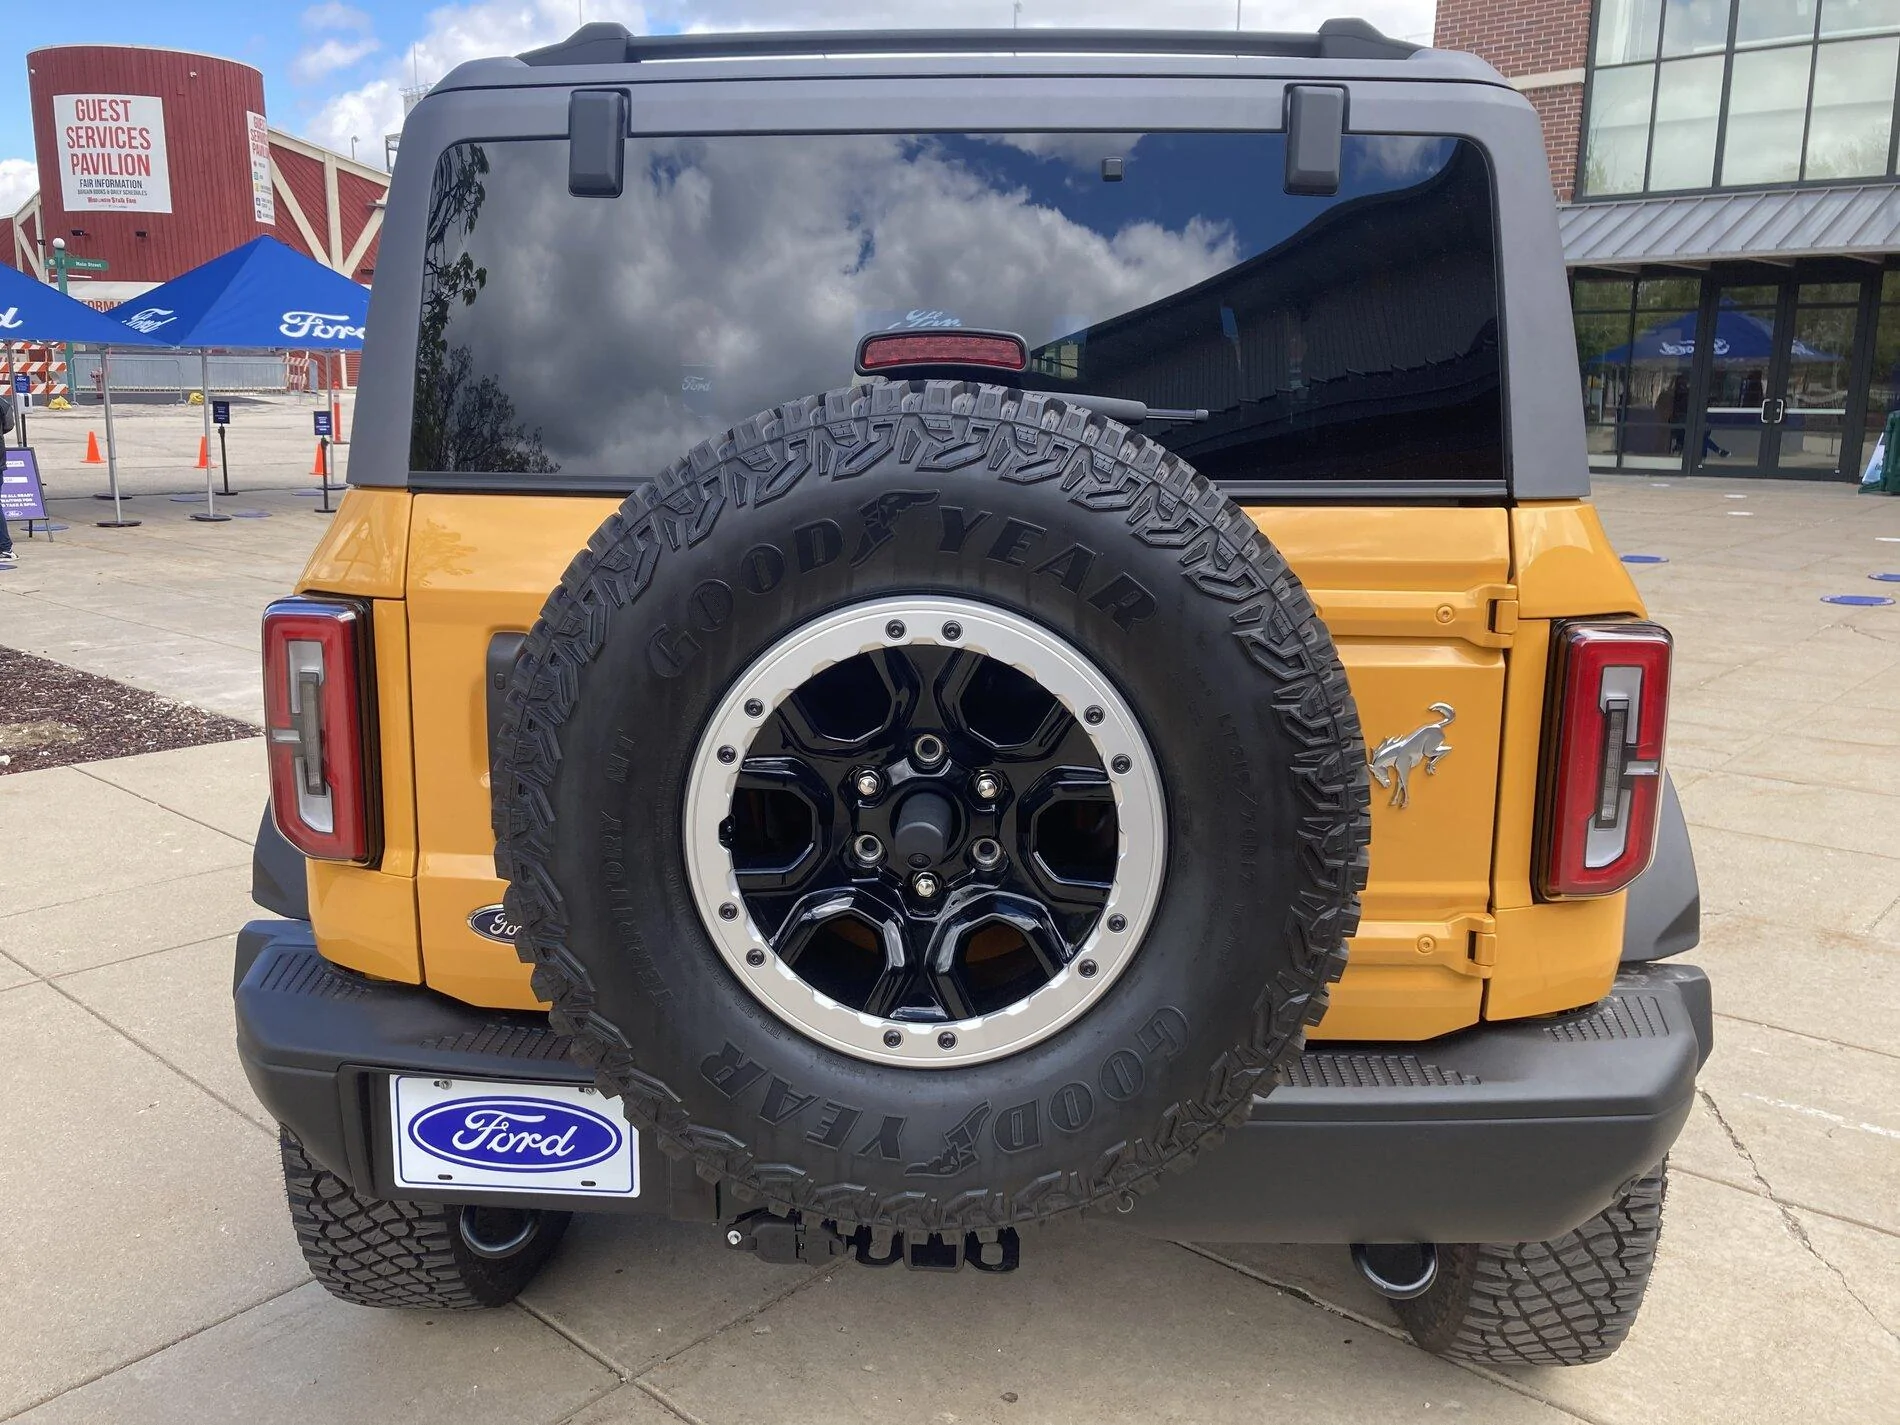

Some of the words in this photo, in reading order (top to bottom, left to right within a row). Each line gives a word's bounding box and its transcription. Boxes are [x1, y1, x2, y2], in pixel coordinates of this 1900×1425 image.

[75, 99, 131, 122] GUEST
[66, 126, 151, 150] SERVICES
[70, 153, 151, 176] PAVILION
[79, 179, 93, 188] FAIR
[94, 179, 143, 189] INFORMATION
[279, 311, 365, 339] For
[682, 376, 712, 391] Ford
[489, 912, 522, 935] Fo
[452, 1109, 578, 1157] Ford
